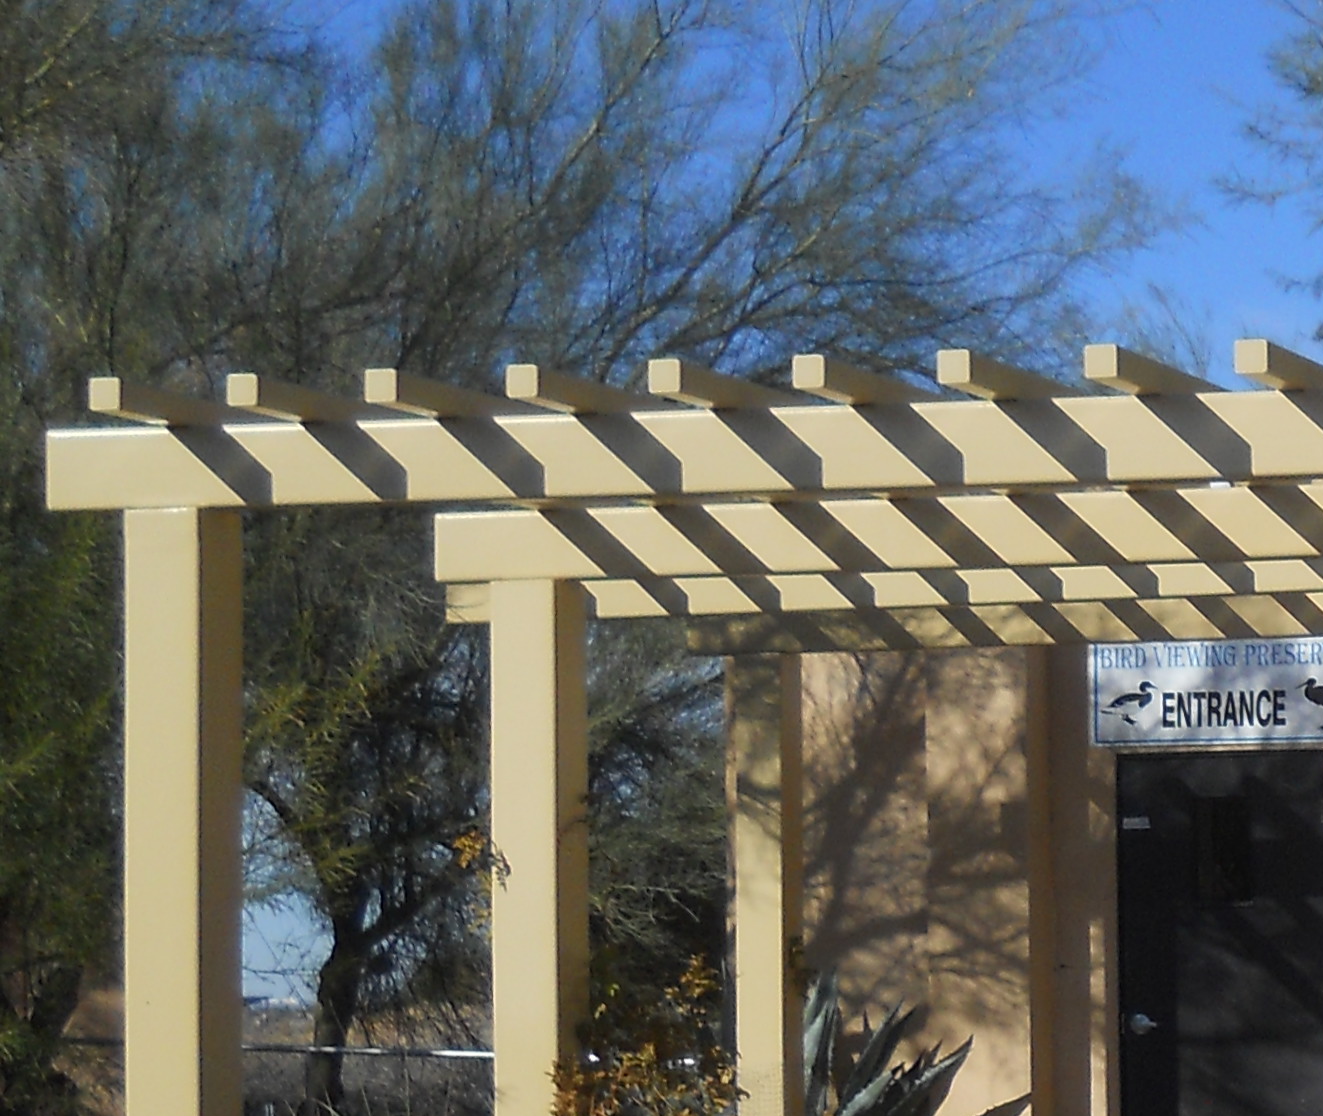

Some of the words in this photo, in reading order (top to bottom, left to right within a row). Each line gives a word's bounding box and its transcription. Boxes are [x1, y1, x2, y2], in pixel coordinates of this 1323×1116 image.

[1101, 647, 1146, 669] BIRD
[1154, 643, 1236, 668] VIEWING
[1162, 689, 1286, 728] ENTRANCE
